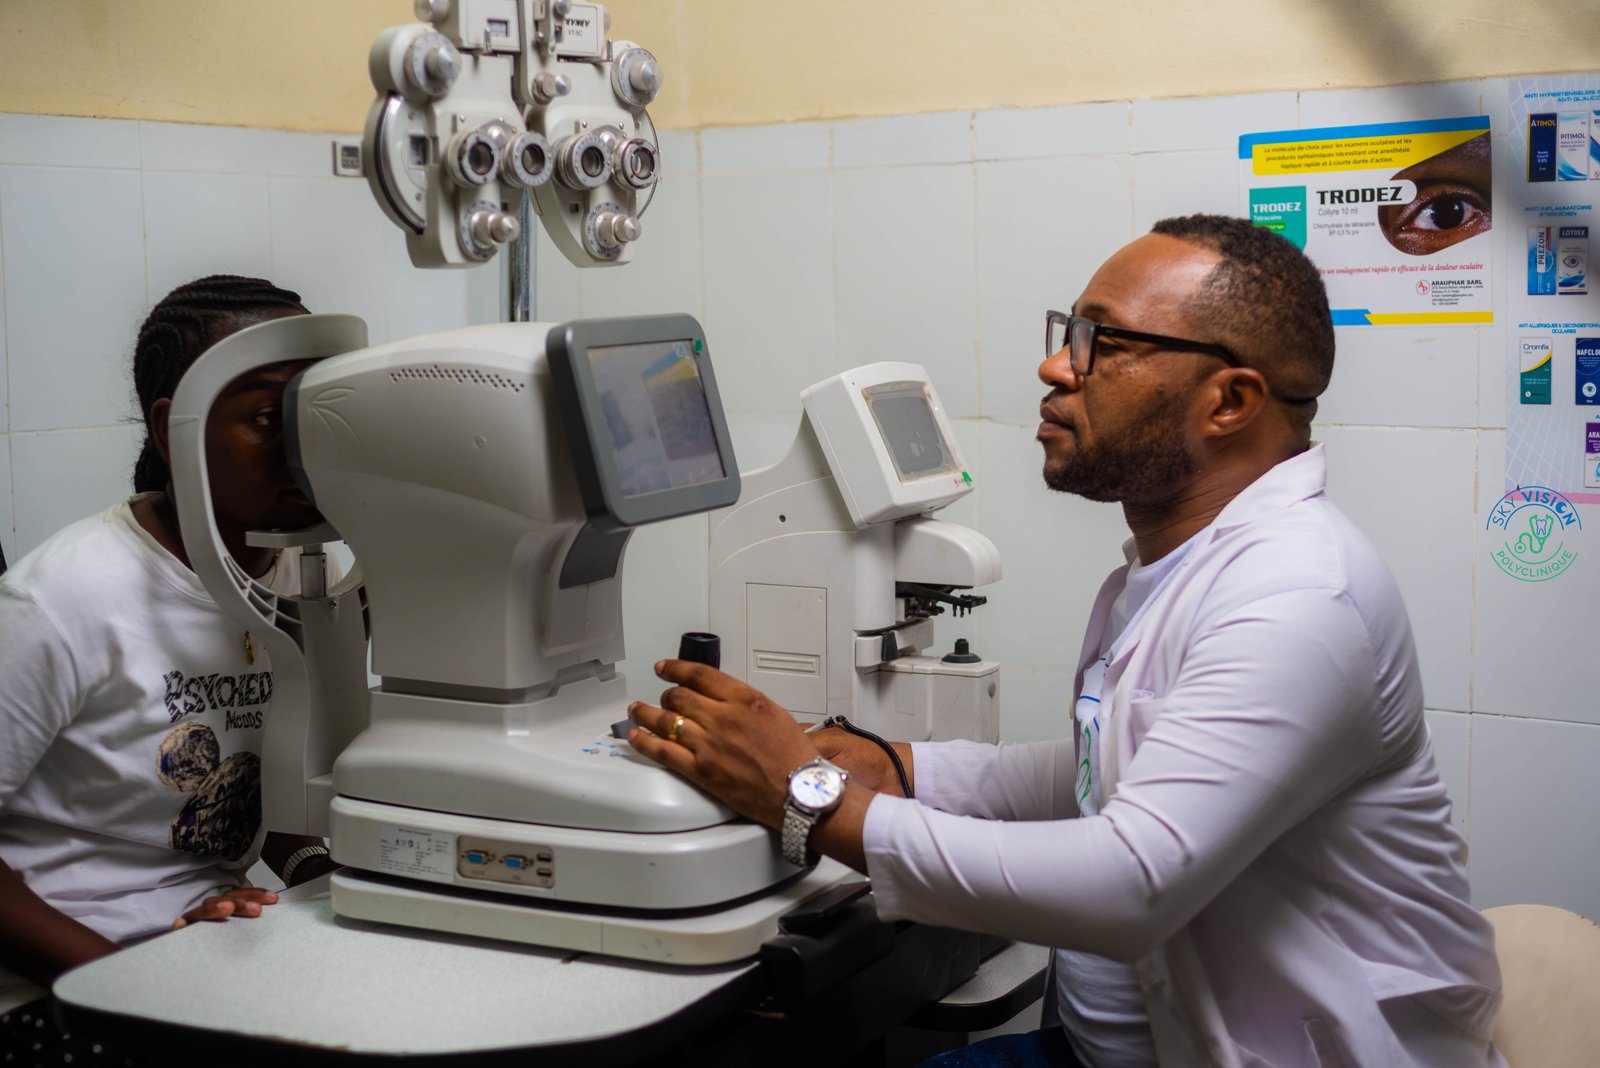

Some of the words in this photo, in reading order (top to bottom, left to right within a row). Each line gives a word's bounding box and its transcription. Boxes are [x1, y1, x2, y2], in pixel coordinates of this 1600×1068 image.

[1316, 186, 1403, 205] TRODEZ
[1252, 202, 1302, 213] TRODEZ
[1318, 208, 1340, 216] Collyre
[1341, 207, 1349, 215] 10
[1435, 263, 1458, 271] douleur
[1459, 262, 1483, 270] oculaire
[163, 671, 273, 723] PSYCHED
